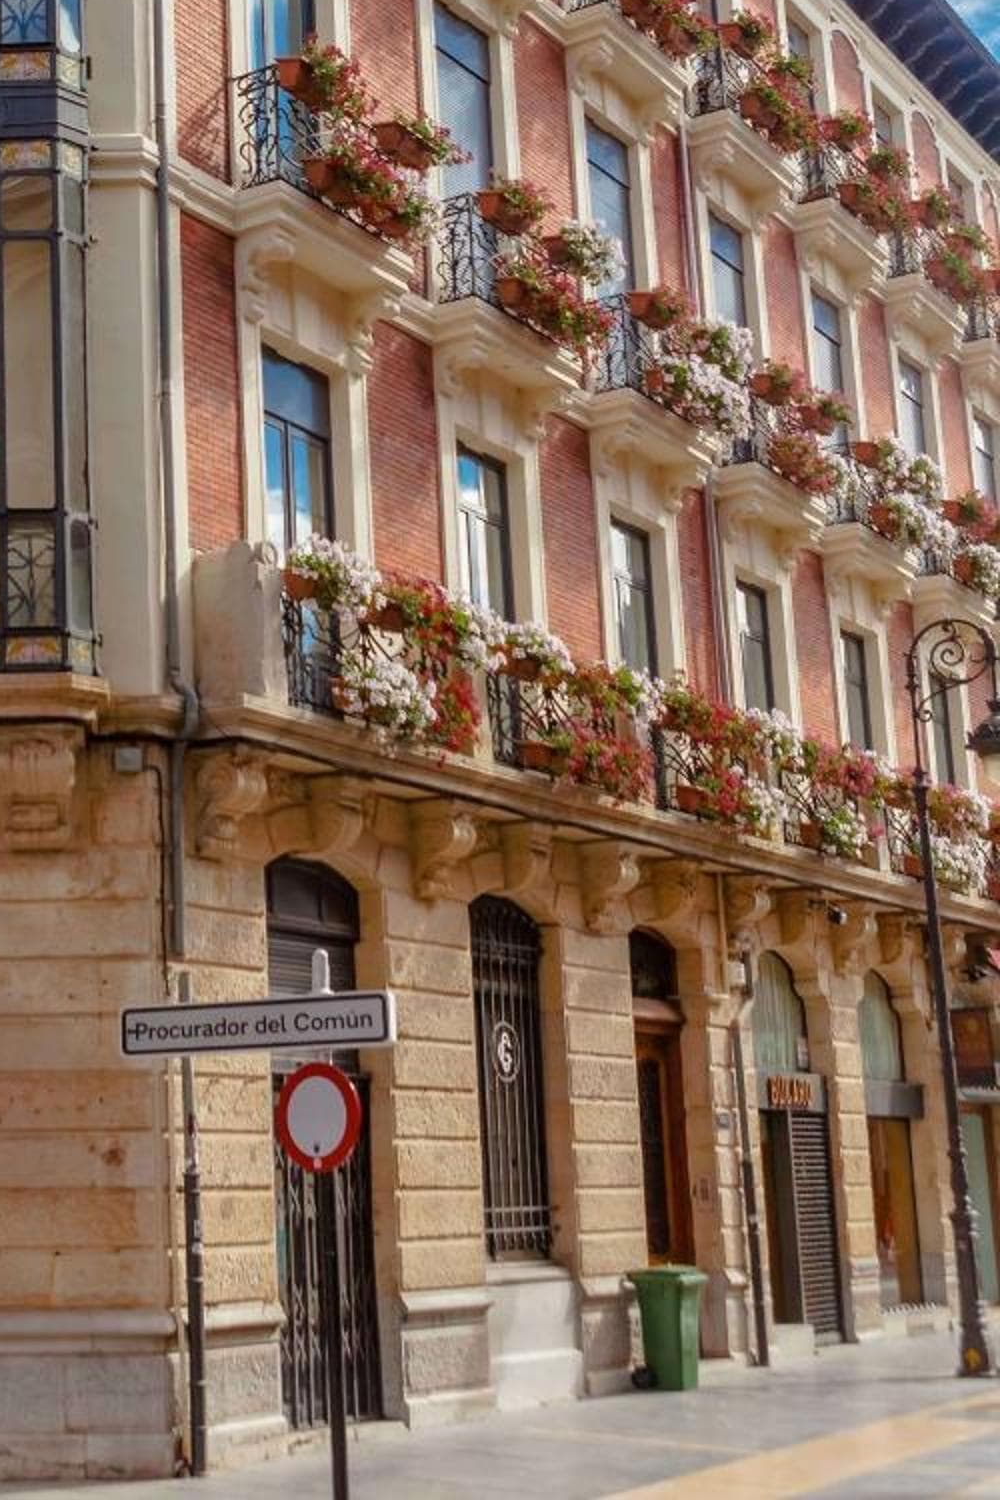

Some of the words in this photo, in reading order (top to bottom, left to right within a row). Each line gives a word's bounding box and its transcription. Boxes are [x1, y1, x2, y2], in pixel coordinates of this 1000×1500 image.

[136, 1018, 248, 1041] Procurador
[255, 1014, 287, 1034] del
[294, 1009, 373, 1032] Común
